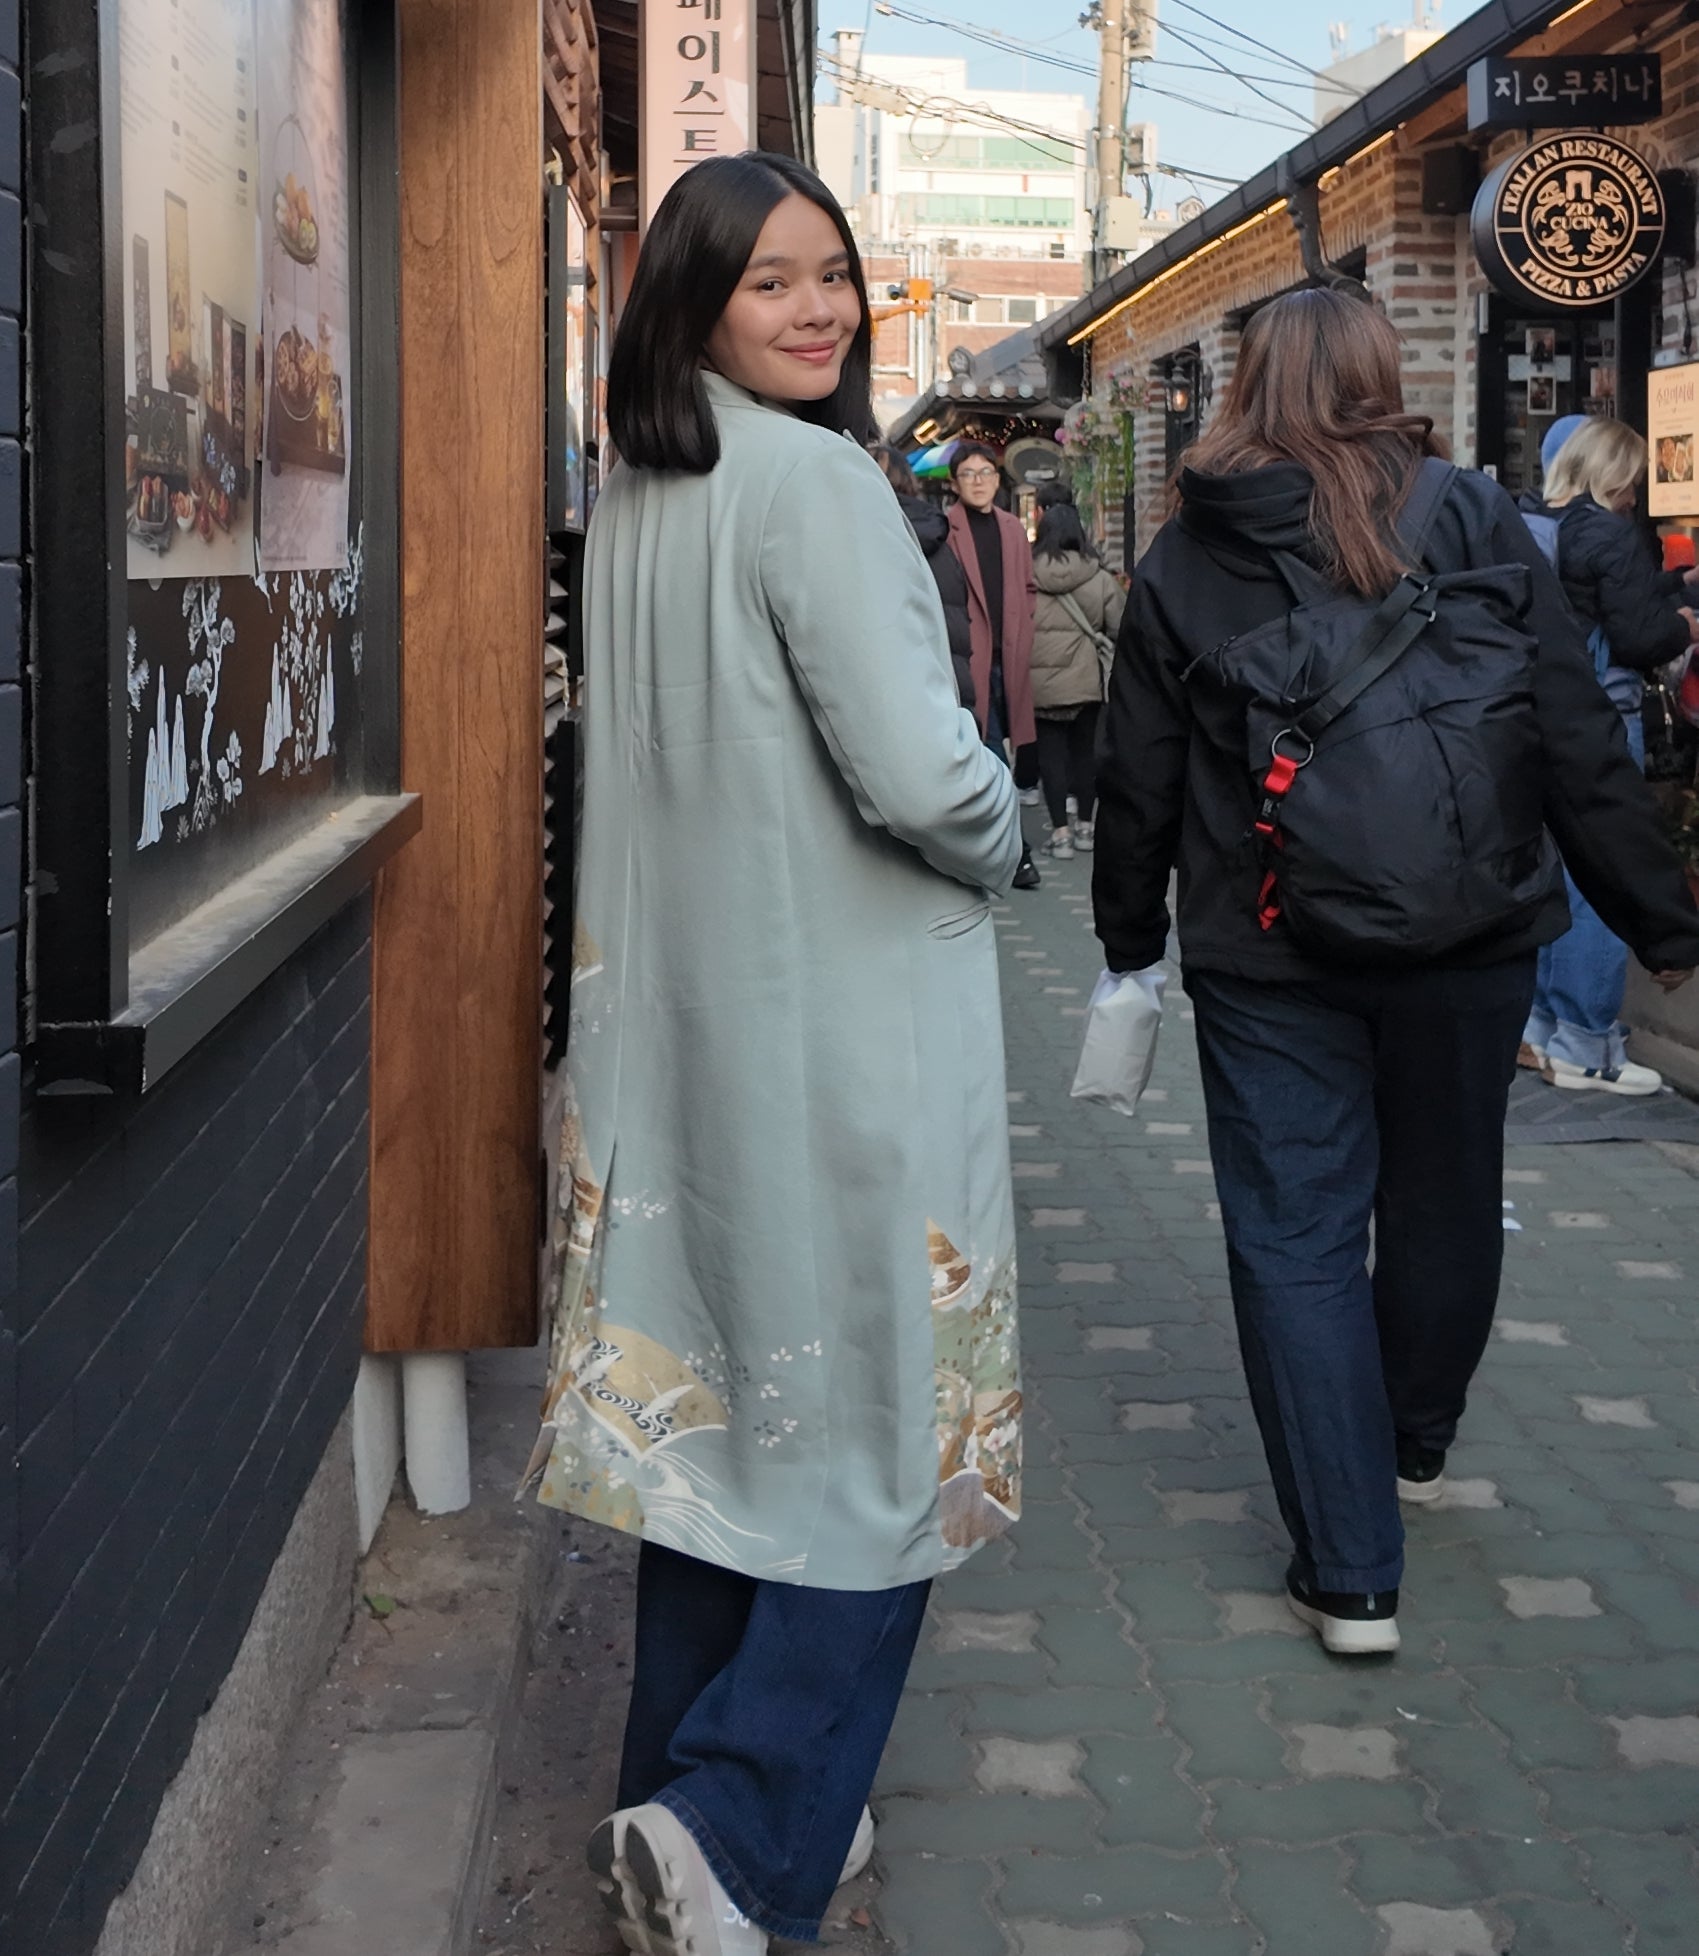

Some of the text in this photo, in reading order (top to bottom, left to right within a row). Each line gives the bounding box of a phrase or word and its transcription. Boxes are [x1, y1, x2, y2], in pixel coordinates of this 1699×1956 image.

[1494, 66, 1654, 106] 지오쿠치나
[1560, 140, 1659, 215] RESTAURANT
[1550, 216, 1609, 231] CUCINA
[1564, 202, 1594, 216] ZIO
[1519, 251, 1648, 297] PIZZA & PASTA
